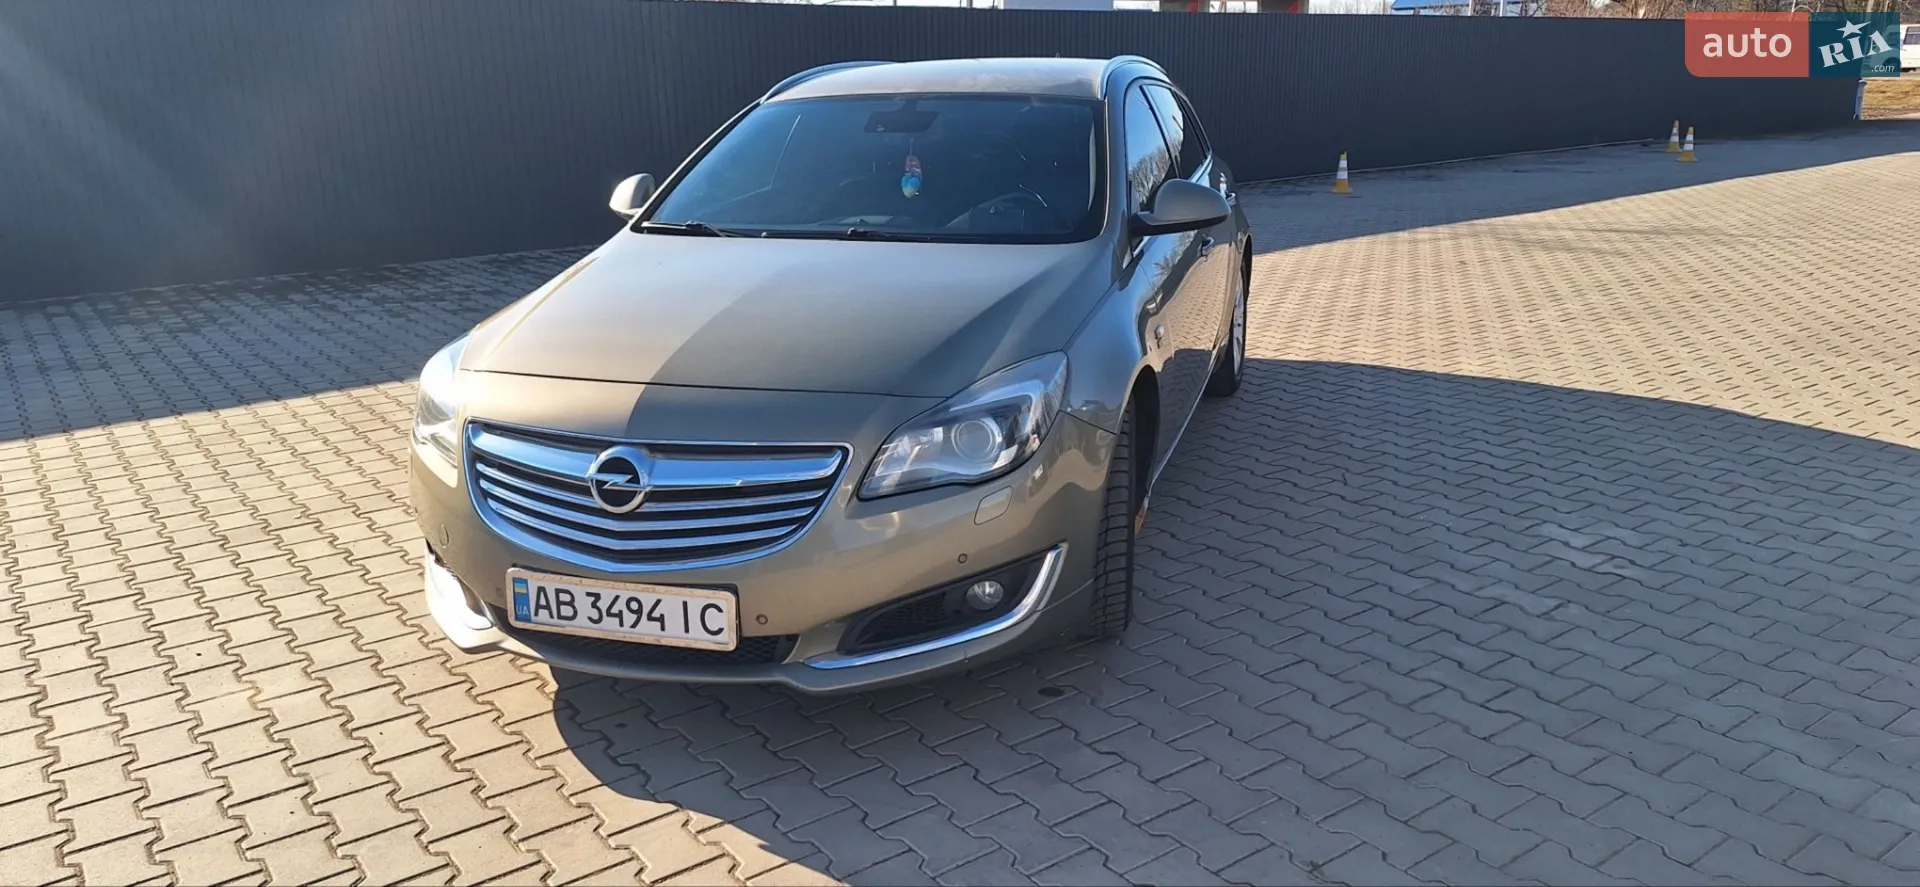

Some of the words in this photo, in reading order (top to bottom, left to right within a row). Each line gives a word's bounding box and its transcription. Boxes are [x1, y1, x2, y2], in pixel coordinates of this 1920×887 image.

[515, 604, 530, 616] UA
[533, 586, 578, 622] AB
[585, 591, 666, 632] 3494
[682, 600, 725, 636] IC
